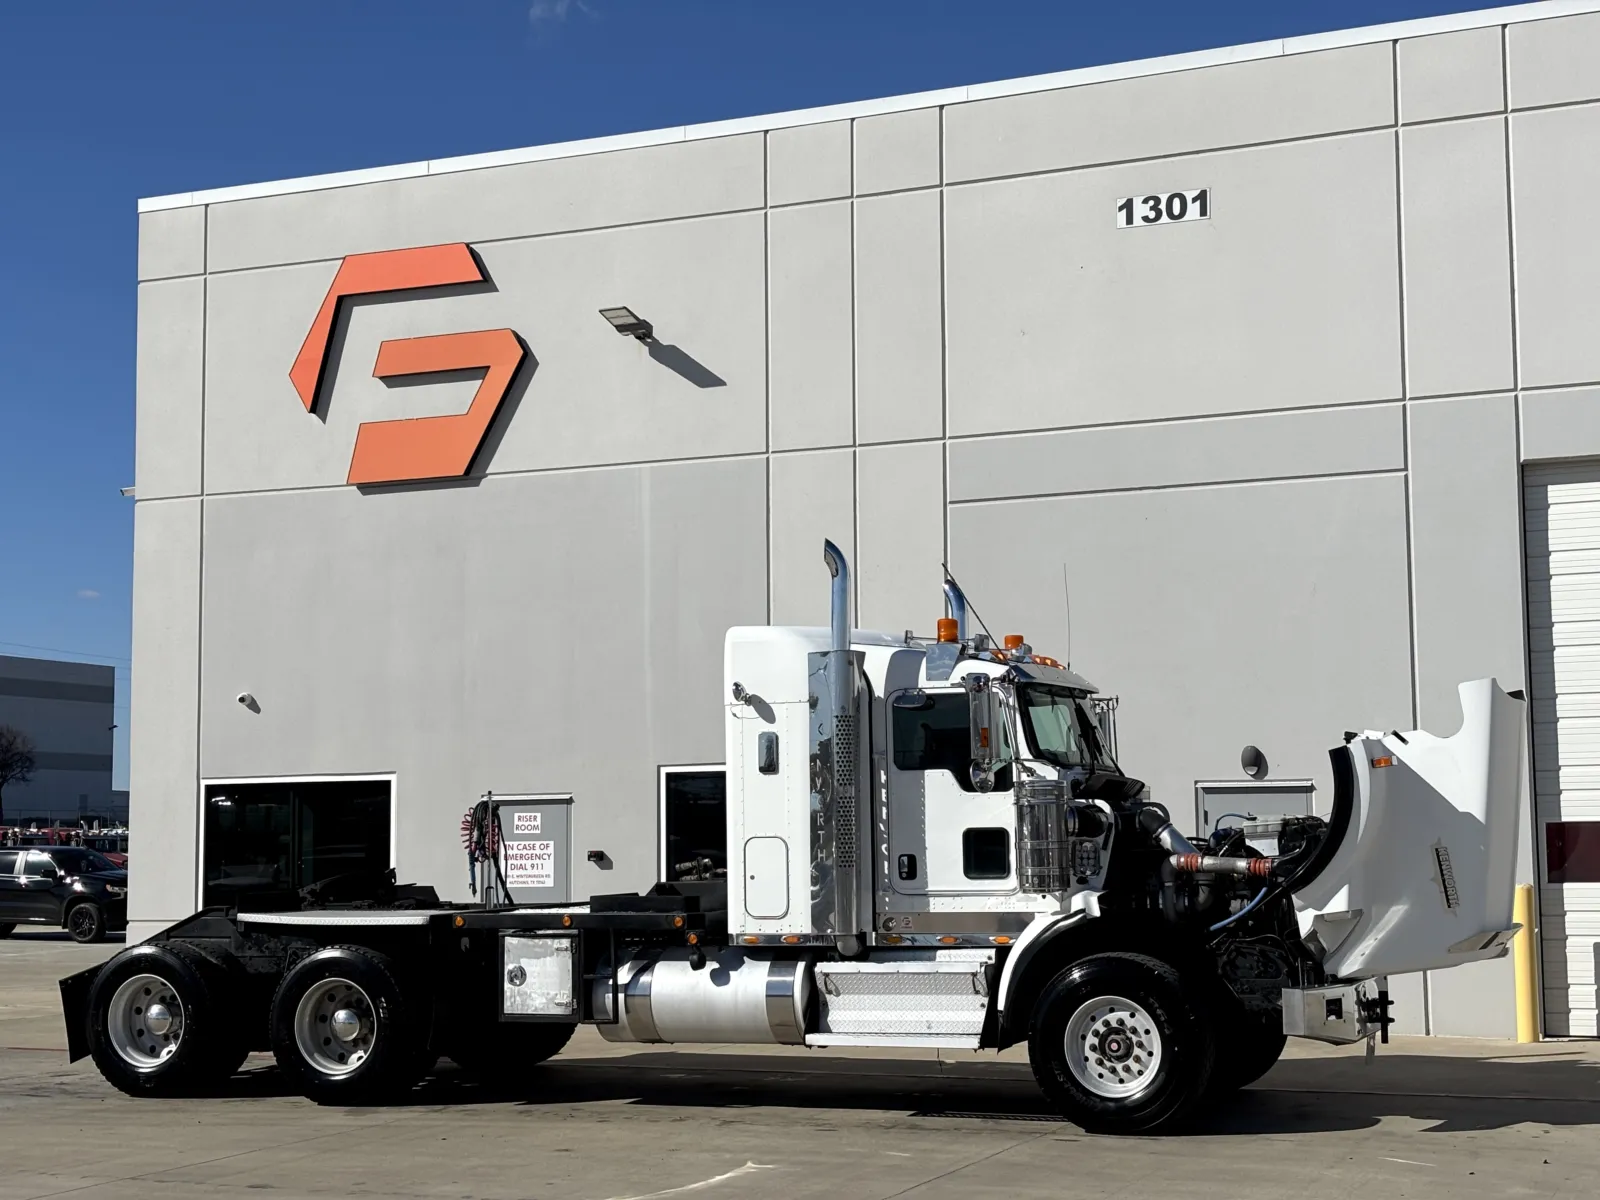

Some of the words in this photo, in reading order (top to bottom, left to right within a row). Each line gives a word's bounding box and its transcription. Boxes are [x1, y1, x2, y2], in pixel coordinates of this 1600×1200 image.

[1117, 189, 1207, 226] 1301
[516, 843, 536, 851] CASE
[538, 843, 550, 851] OF
[503, 853, 552, 861] EMERGENCY
[510, 863, 528, 871] DIAL
[530, 863, 544, 871] 911
[1438, 846, 1460, 908] KENWORTH
